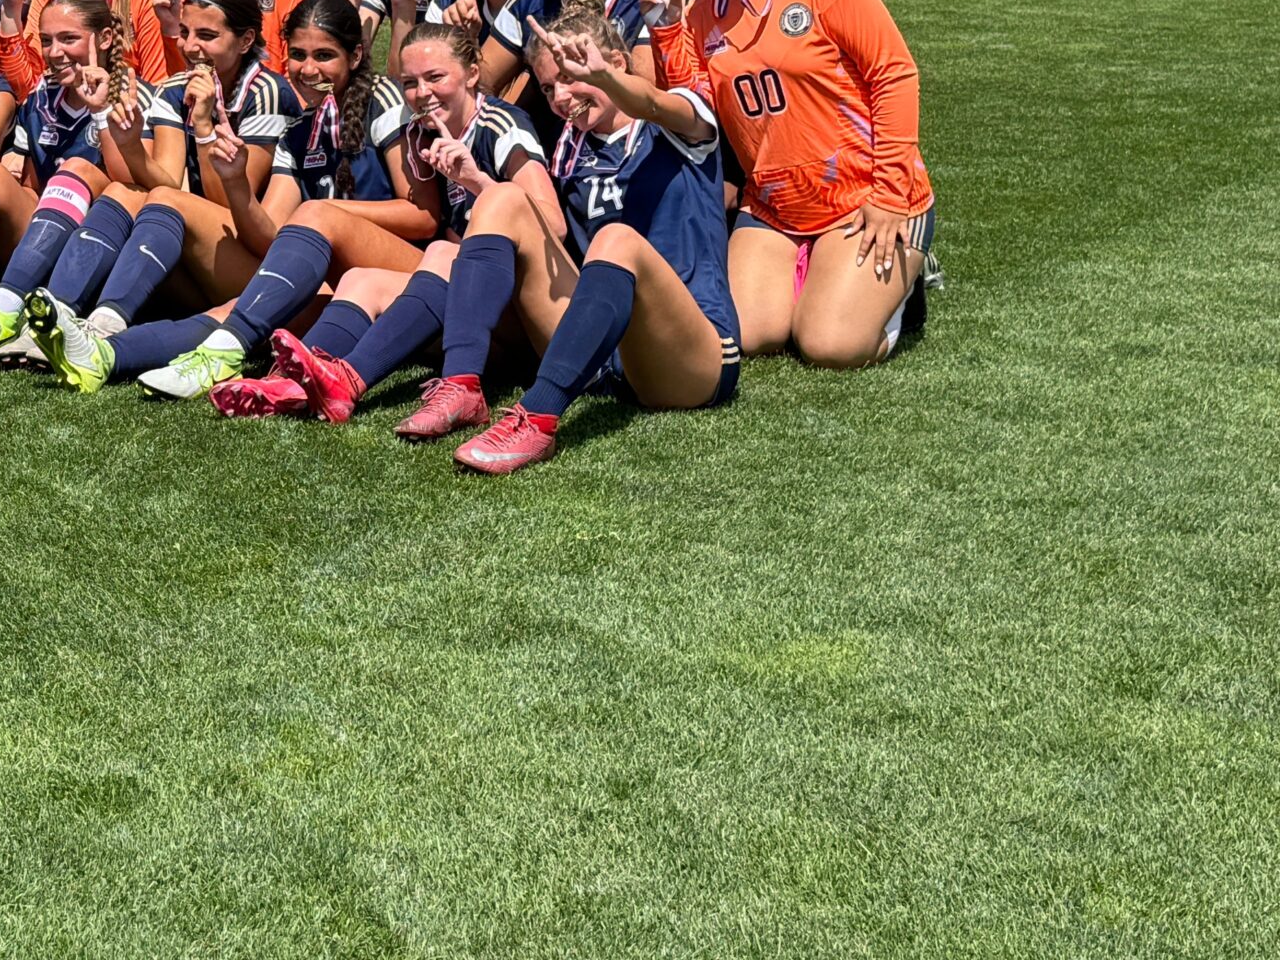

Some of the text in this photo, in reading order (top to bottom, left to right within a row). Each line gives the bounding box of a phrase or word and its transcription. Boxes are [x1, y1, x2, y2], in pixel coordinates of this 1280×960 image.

[732, 68, 788, 119] 00
[46, 187, 74, 201] APTAIN
[583, 174, 625, 220] 24
